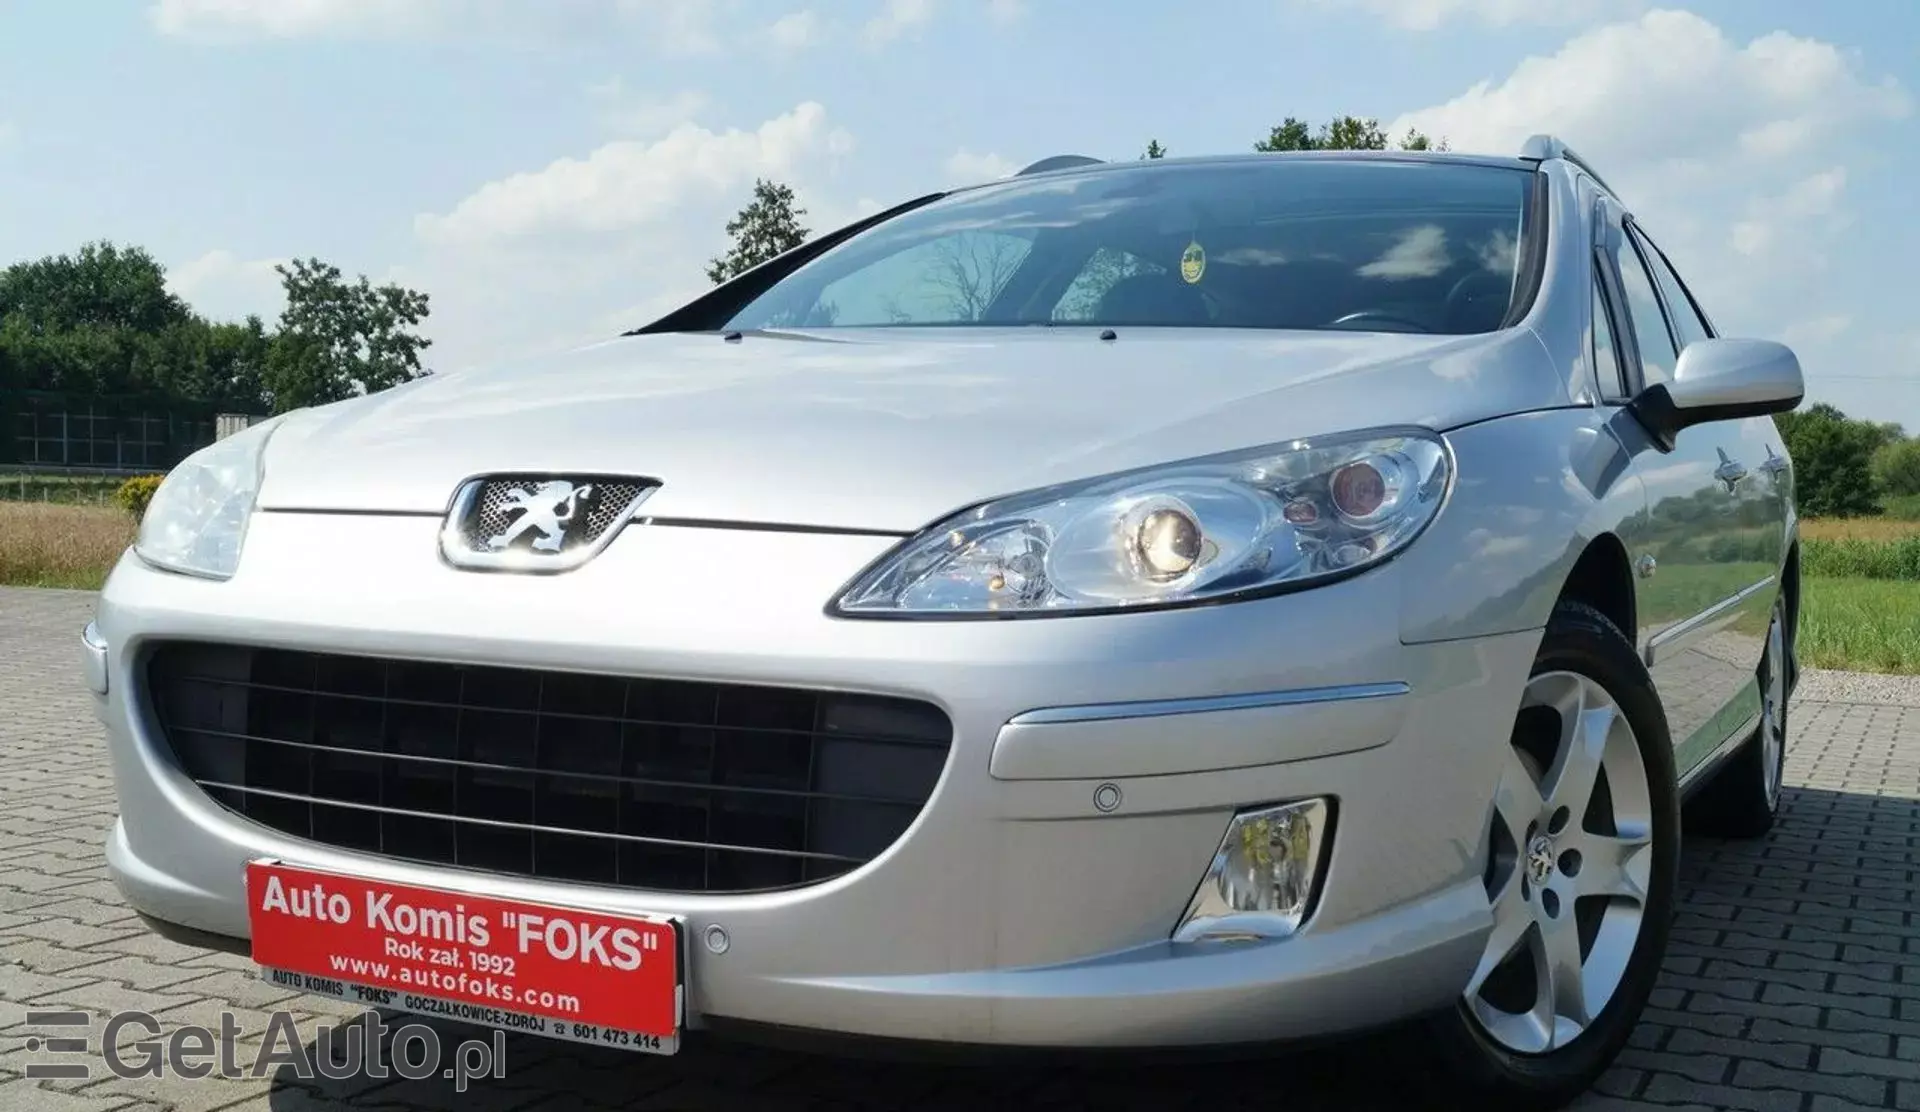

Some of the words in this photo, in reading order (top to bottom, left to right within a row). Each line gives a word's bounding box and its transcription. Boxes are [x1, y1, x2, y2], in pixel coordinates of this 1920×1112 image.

[262, 875, 351, 924] Auto
[366, 891, 490, 947] Komis
[502, 911, 658, 971] "FOKS"
[385, 937, 425, 963] Rok
[428, 945, 464, 969] zał.
[469, 951, 516, 977] 1992
[272, 969, 302, 988] AUTO
[305, 975, 344, 997] KOMIS
[573, 1025, 599, 1041] 601
[602, 1028, 630, 1046] 473
[633, 1033, 661, 1050] 414
[330, 954, 580, 1013] www.autofoks.com
